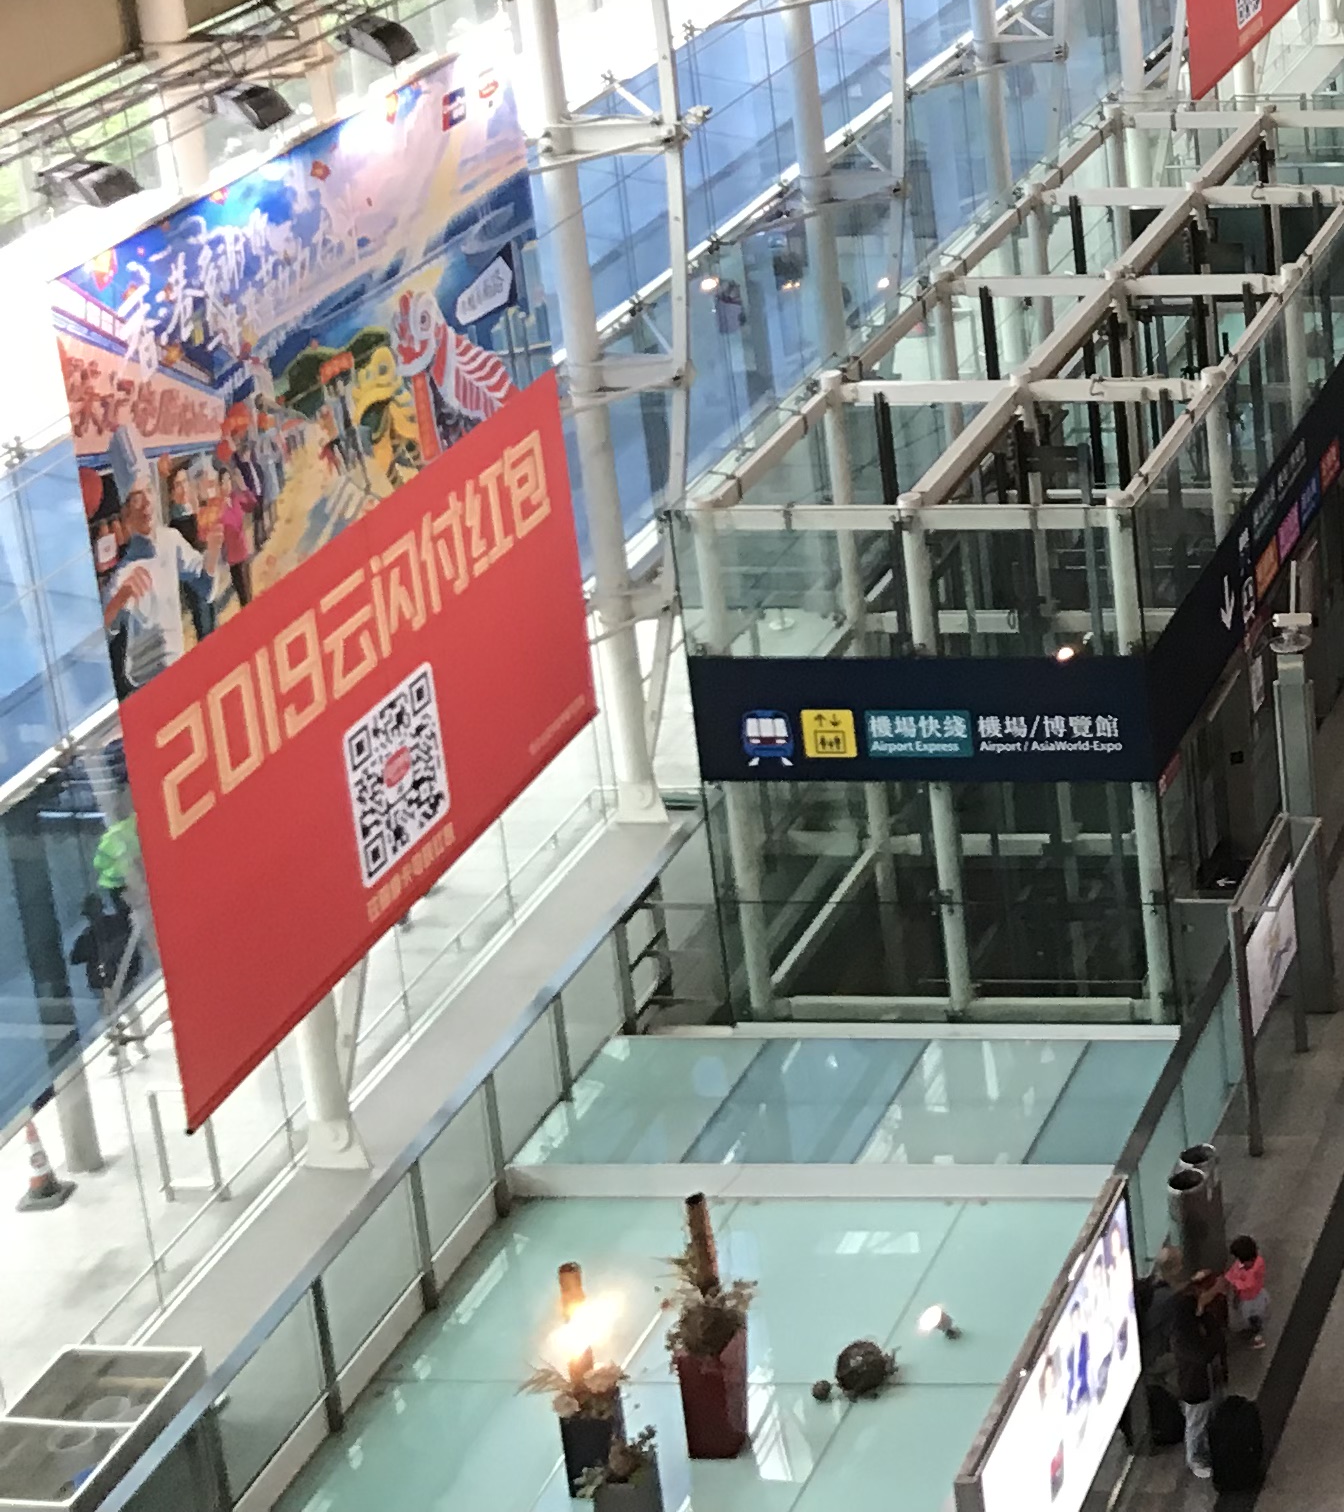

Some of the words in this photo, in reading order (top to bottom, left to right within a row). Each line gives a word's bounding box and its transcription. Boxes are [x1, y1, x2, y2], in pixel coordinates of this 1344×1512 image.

[156, 430, 551, 839] 2019云闪付红包
[872, 741, 914, 753] Airport
[915, 741, 959, 753] Express
[979, 741, 1021, 753] Airport
[1031, 740, 1122, 752] AsiaWorld-Expo
